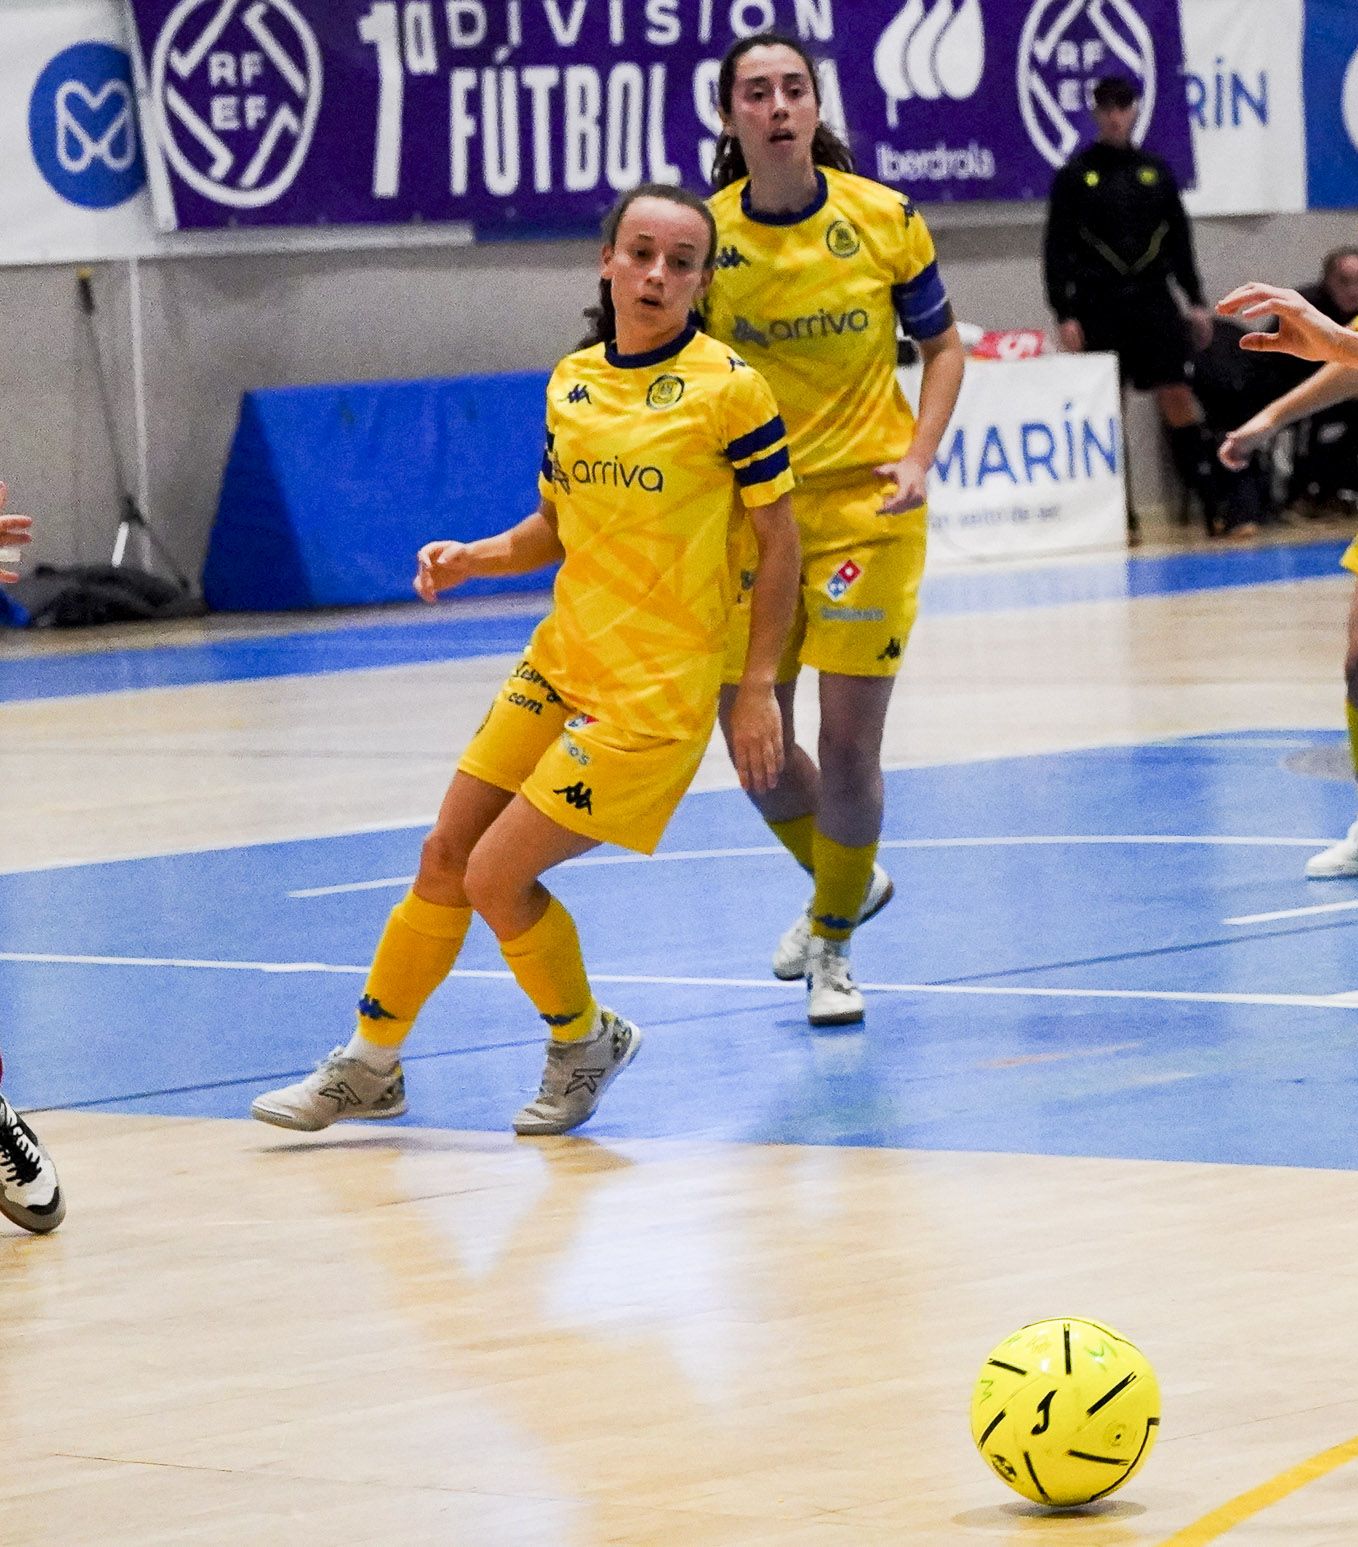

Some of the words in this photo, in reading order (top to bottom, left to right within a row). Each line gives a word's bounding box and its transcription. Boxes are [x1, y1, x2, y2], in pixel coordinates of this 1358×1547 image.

[208, 50, 265, 87] RF
[210, 93, 268, 130] EF
[449, 44, 682, 195] FÚTBOL
[769, 307, 870, 342] arriva
[572, 455, 664, 493] arriva
